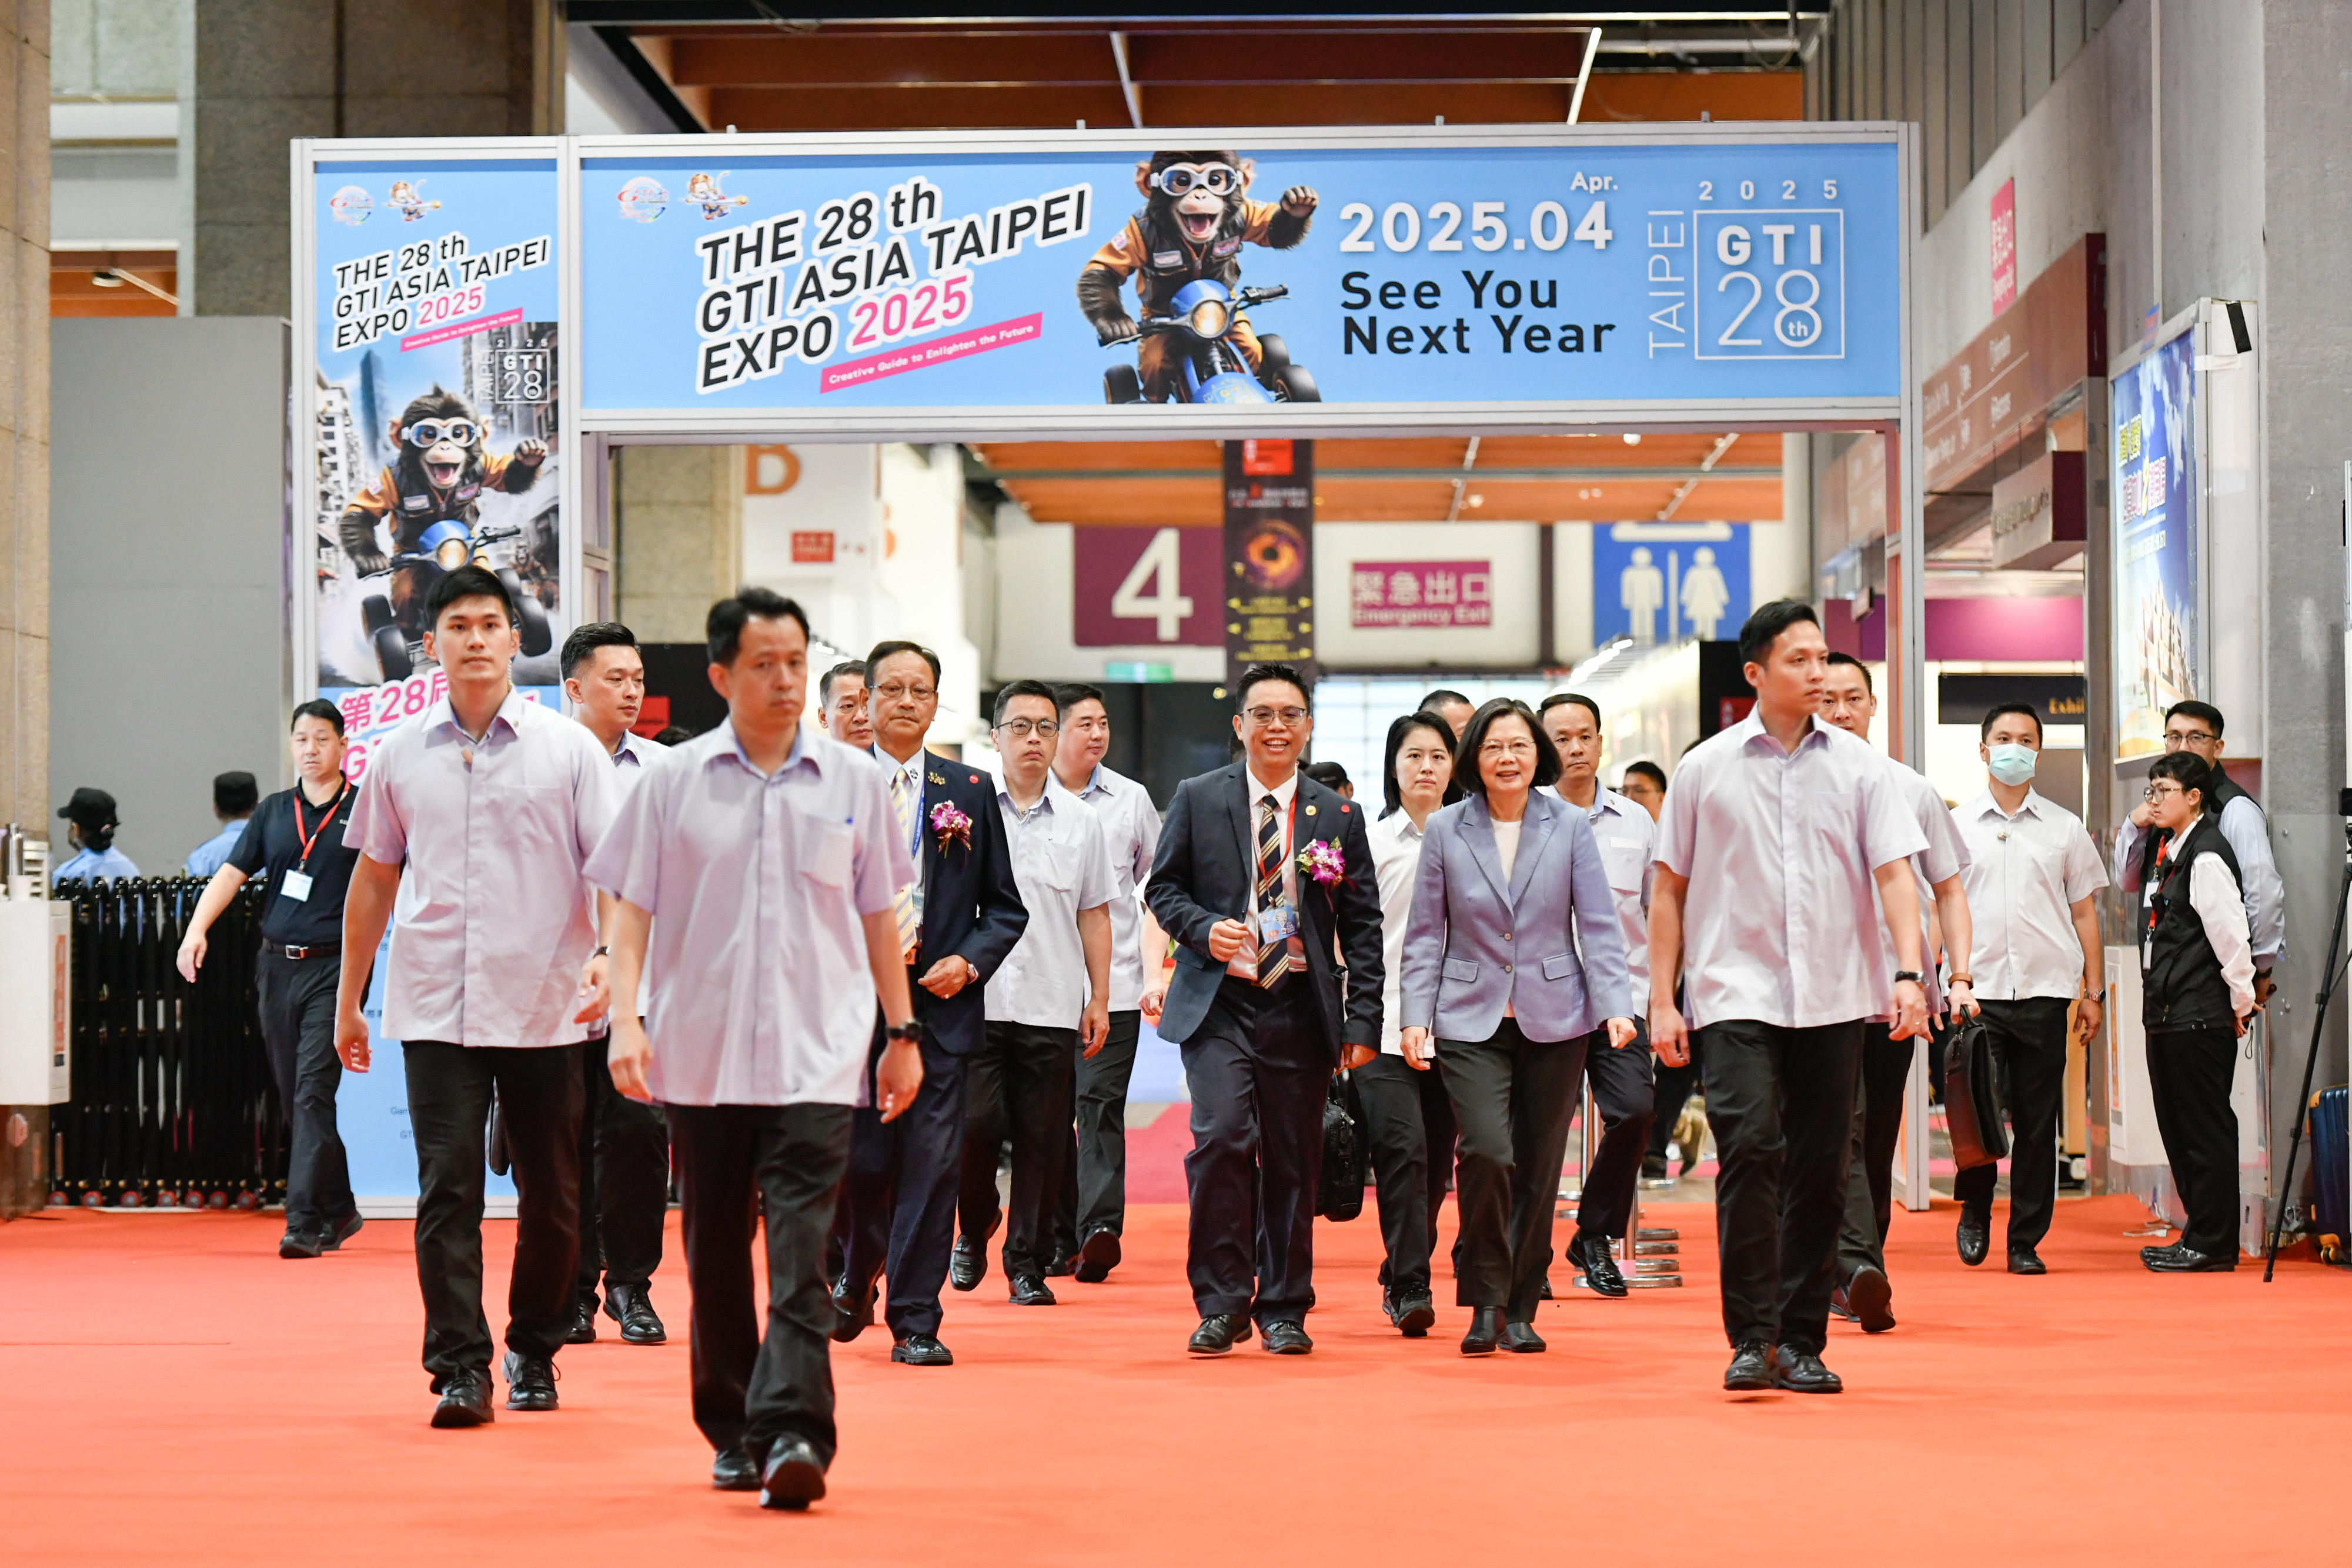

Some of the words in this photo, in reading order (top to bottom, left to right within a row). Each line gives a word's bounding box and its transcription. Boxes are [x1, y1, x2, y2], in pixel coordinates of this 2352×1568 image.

[1570, 171, 1618, 193] Apr.
[702, 217, 799, 280] THE
[818, 198, 873, 250] 28
[891, 183, 935, 228] th
[1339, 200, 1613, 253] 2025.04
[1717, 224, 1822, 266] GTI
[336, 253, 390, 288] THE
[401, 243, 430, 272] 28
[440, 235, 464, 260] th
[337, 286, 378, 318] GTI
[386, 268, 449, 305] ASIA
[460, 238, 548, 283] TAIPEI
[703, 276, 777, 333] GTI
[793, 242, 910, 310] ASIA
[928, 190, 1085, 270] TAIPEI
[1648, 210, 1686, 359] TAIPEI
[1341, 270, 1441, 310] See
[1462, 270, 1557, 309] You
[1718, 269, 1822, 348] 28
[336, 308, 407, 349] EXPO
[419, 286, 482, 325] 2025
[703, 315, 832, 388] EXPO
[853, 275, 967, 346] 2025
[1344, 316, 1471, 355] Next
[1490, 315, 1617, 353] Year
[1788, 321, 1808, 337] th
[479, 349, 495, 400] TAIPEI
[503, 355, 543, 370] GTI
[828, 365, 875, 384] Creative
[877, 357, 909, 372] Guide
[911, 354, 924, 362] to
[926, 339, 977, 359] Enlighten
[979, 334, 997, 346] the
[999, 325, 1034, 340] Future
[504, 370, 542, 400] 28
[1111, 527, 1193, 641] 4
[1354, 570, 1489, 606] 緊急出口
[1354, 607, 1452, 627] Emergency
[1454, 604, 1489, 624] Exit
